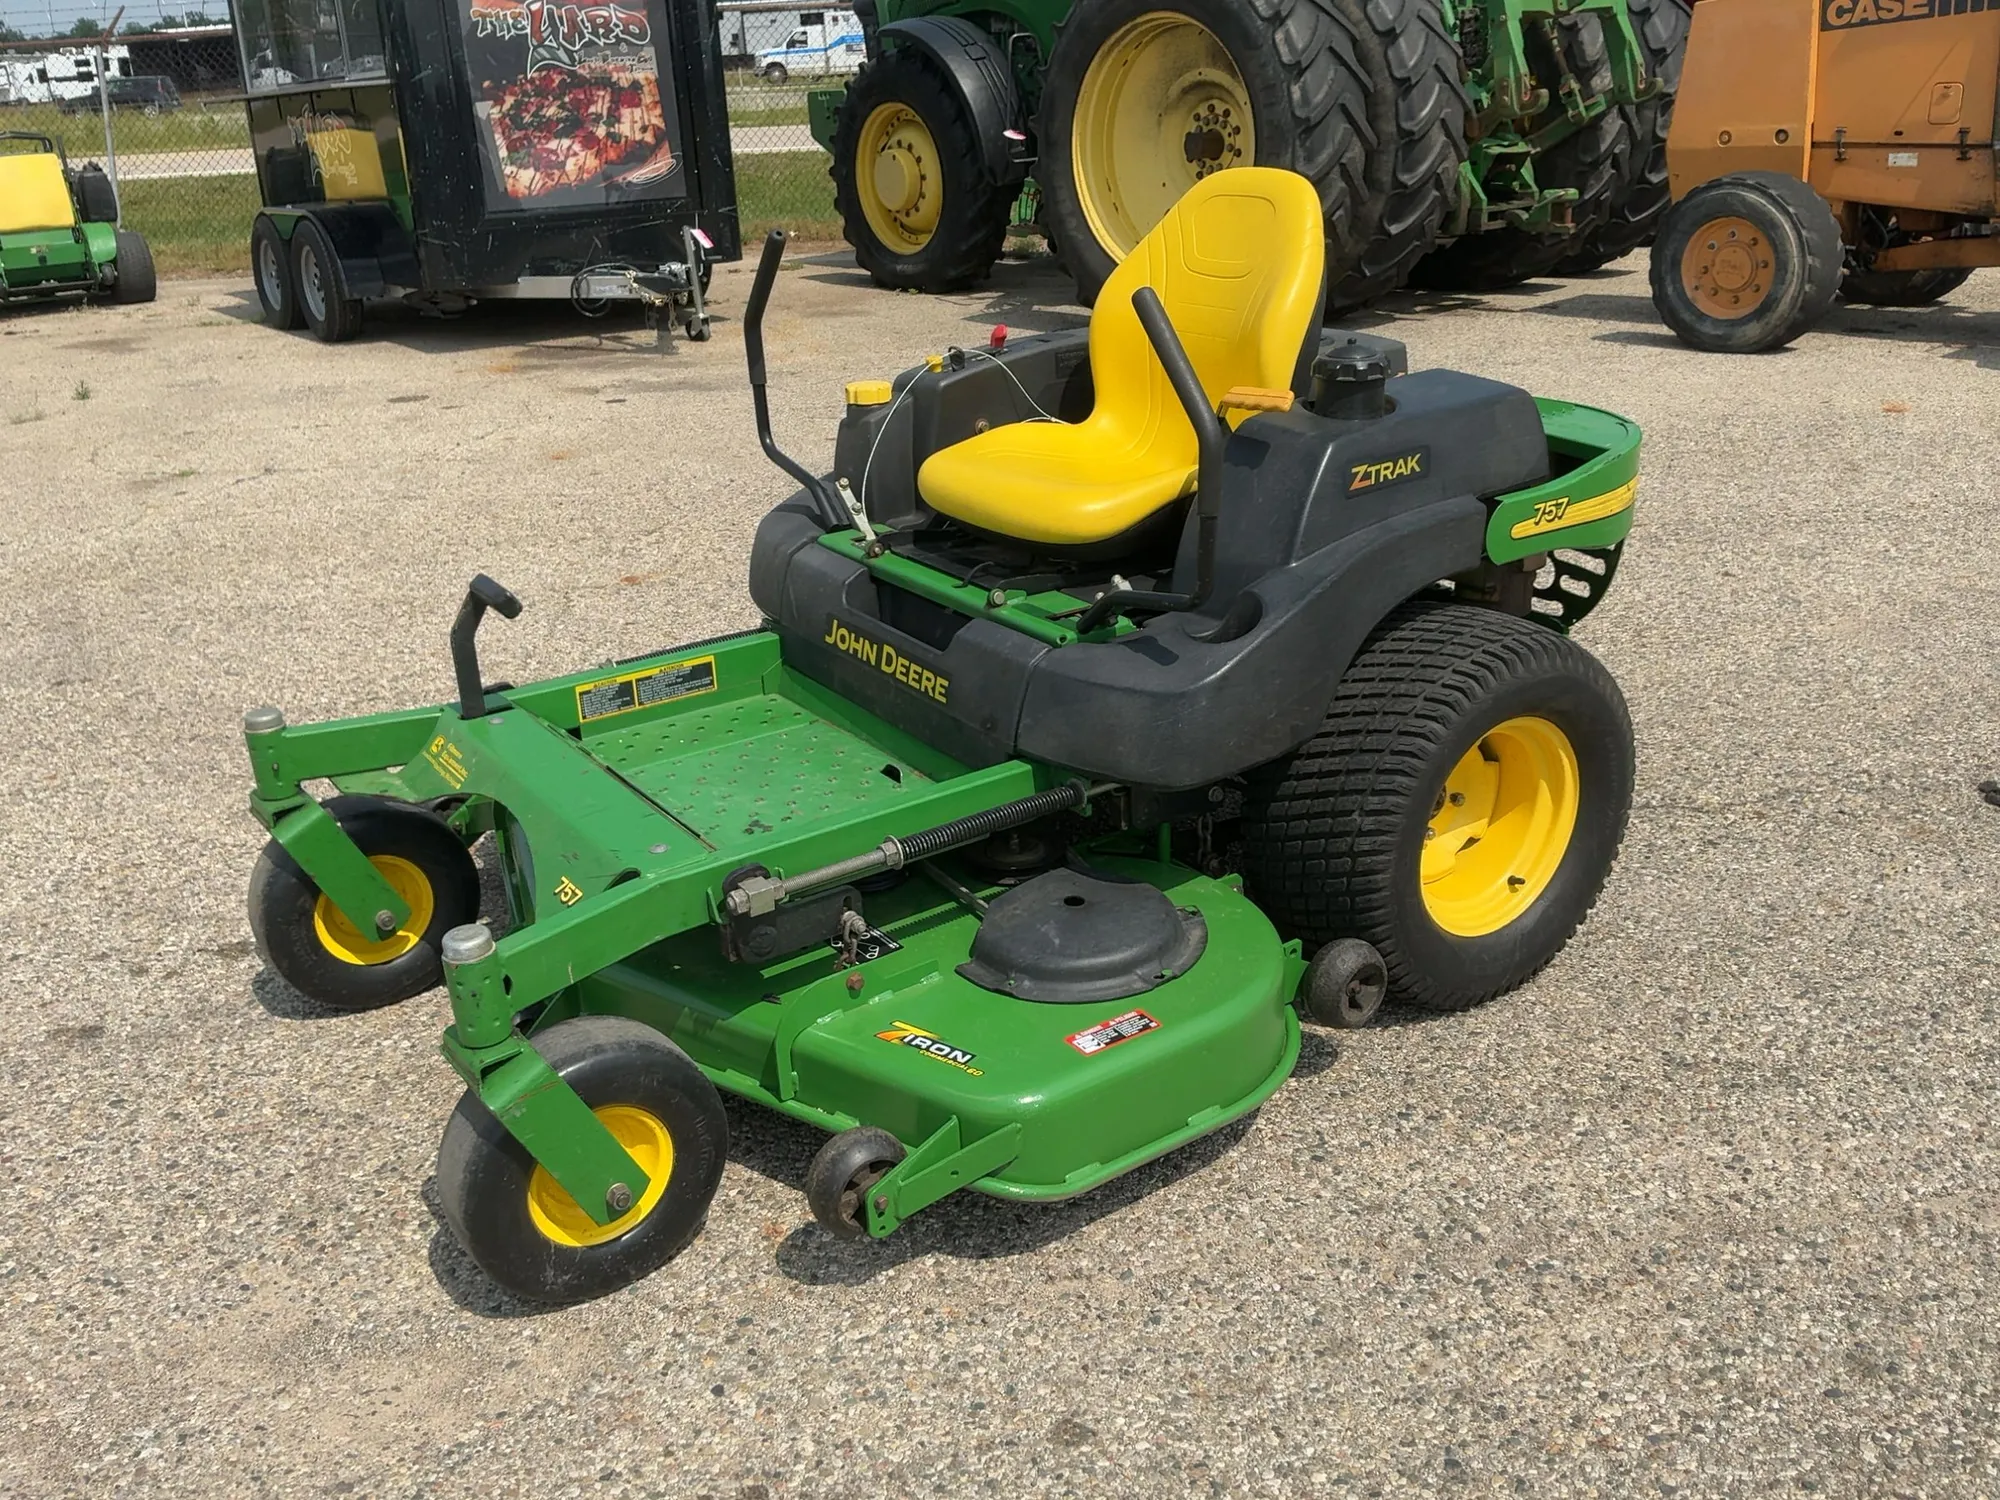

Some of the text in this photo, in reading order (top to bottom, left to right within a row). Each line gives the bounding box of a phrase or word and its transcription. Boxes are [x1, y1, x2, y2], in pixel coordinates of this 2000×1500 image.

[470, 7, 528, 40] THE
[1533, 496, 1570, 526] 757
[825, 619, 949, 704] JOHN DEERE
[553, 876, 583, 908] 757
